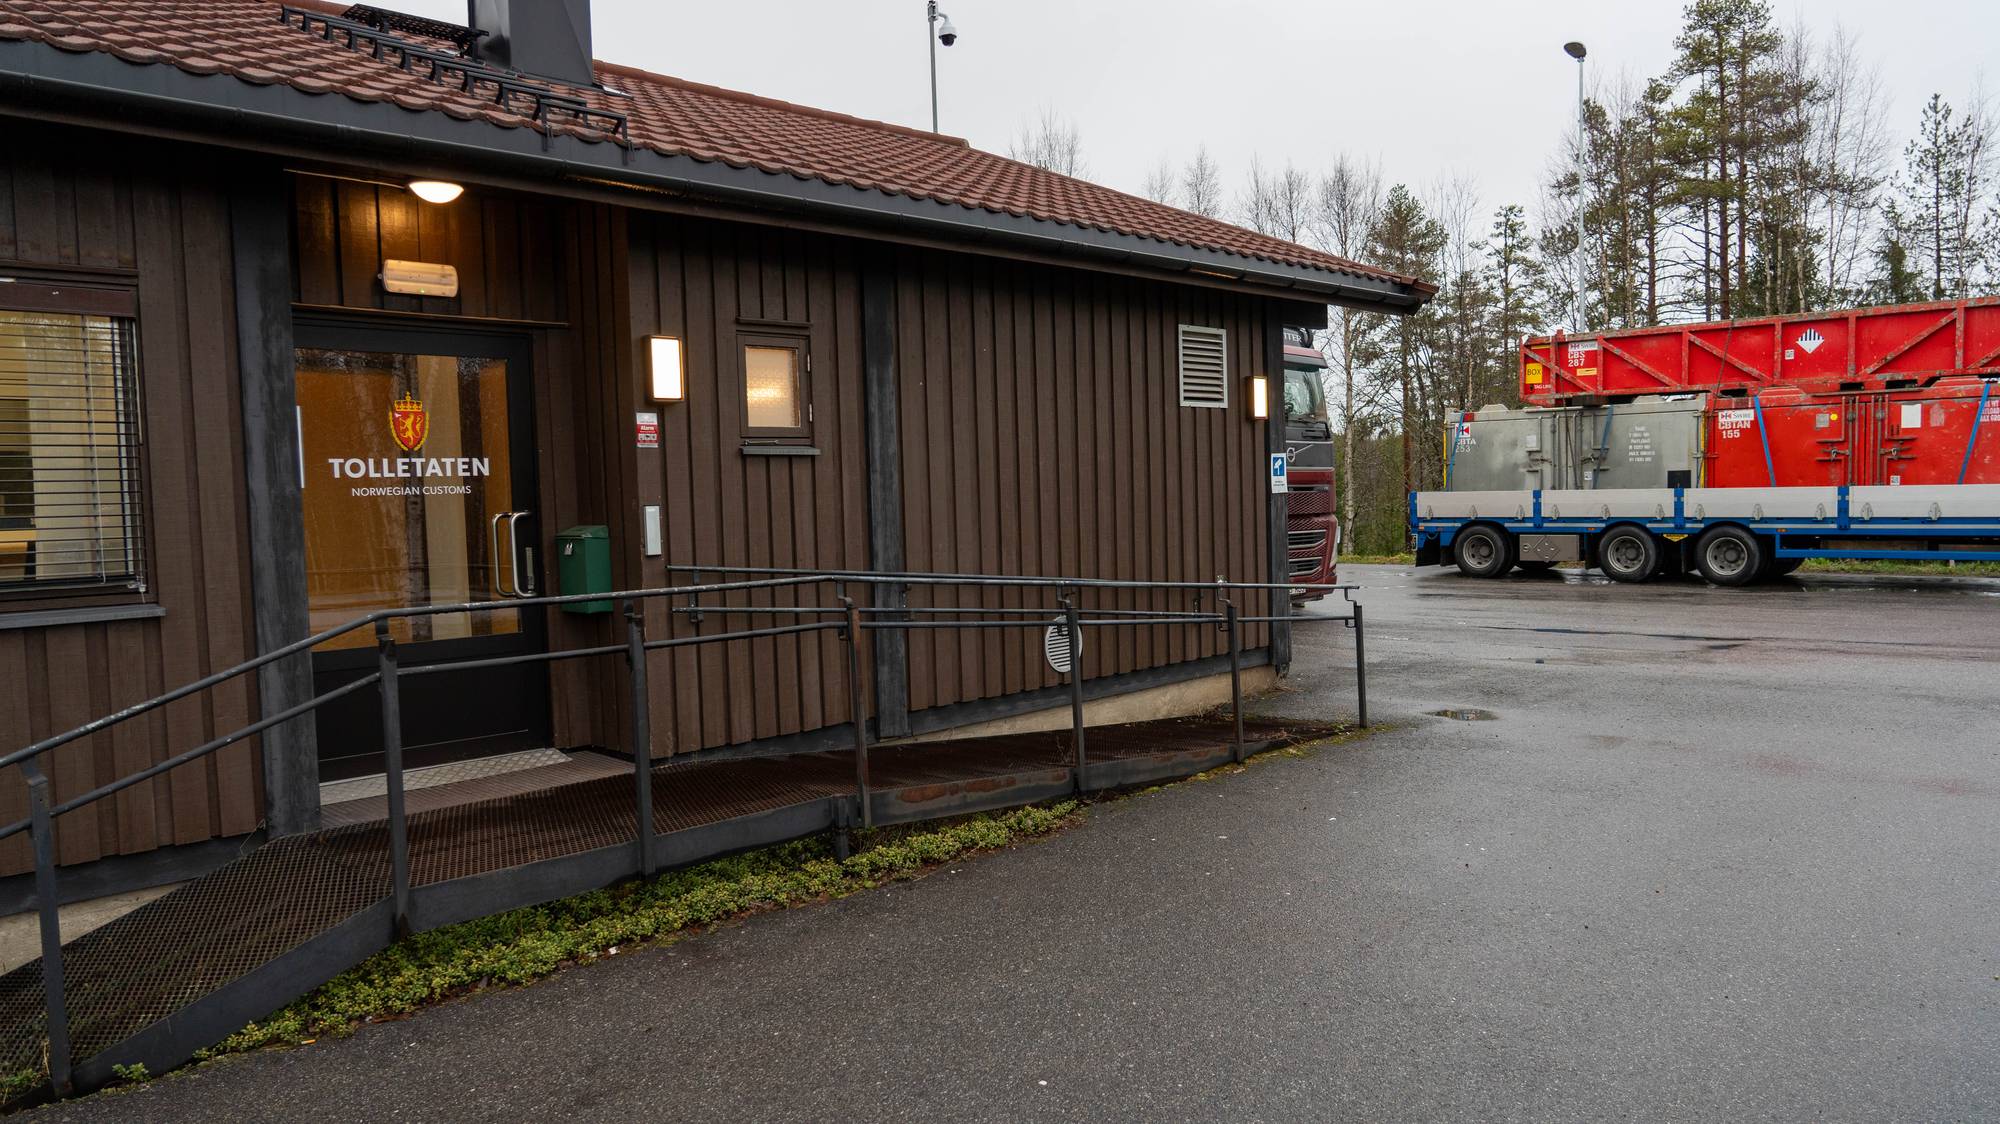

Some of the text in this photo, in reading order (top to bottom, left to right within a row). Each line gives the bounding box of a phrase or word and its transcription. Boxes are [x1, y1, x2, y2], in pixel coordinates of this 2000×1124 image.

[1568, 351, 1585, 359] CBS
[1568, 359, 1585, 367] 287
[1527, 368, 1541, 376] BOX
[1718, 420, 1751, 429] CBTAN
[1722, 429, 1740, 438] 155
[328, 457, 490, 479] TOLLETATEN
[352, 485, 472, 497] NORWEGIAN CUSTOMS
